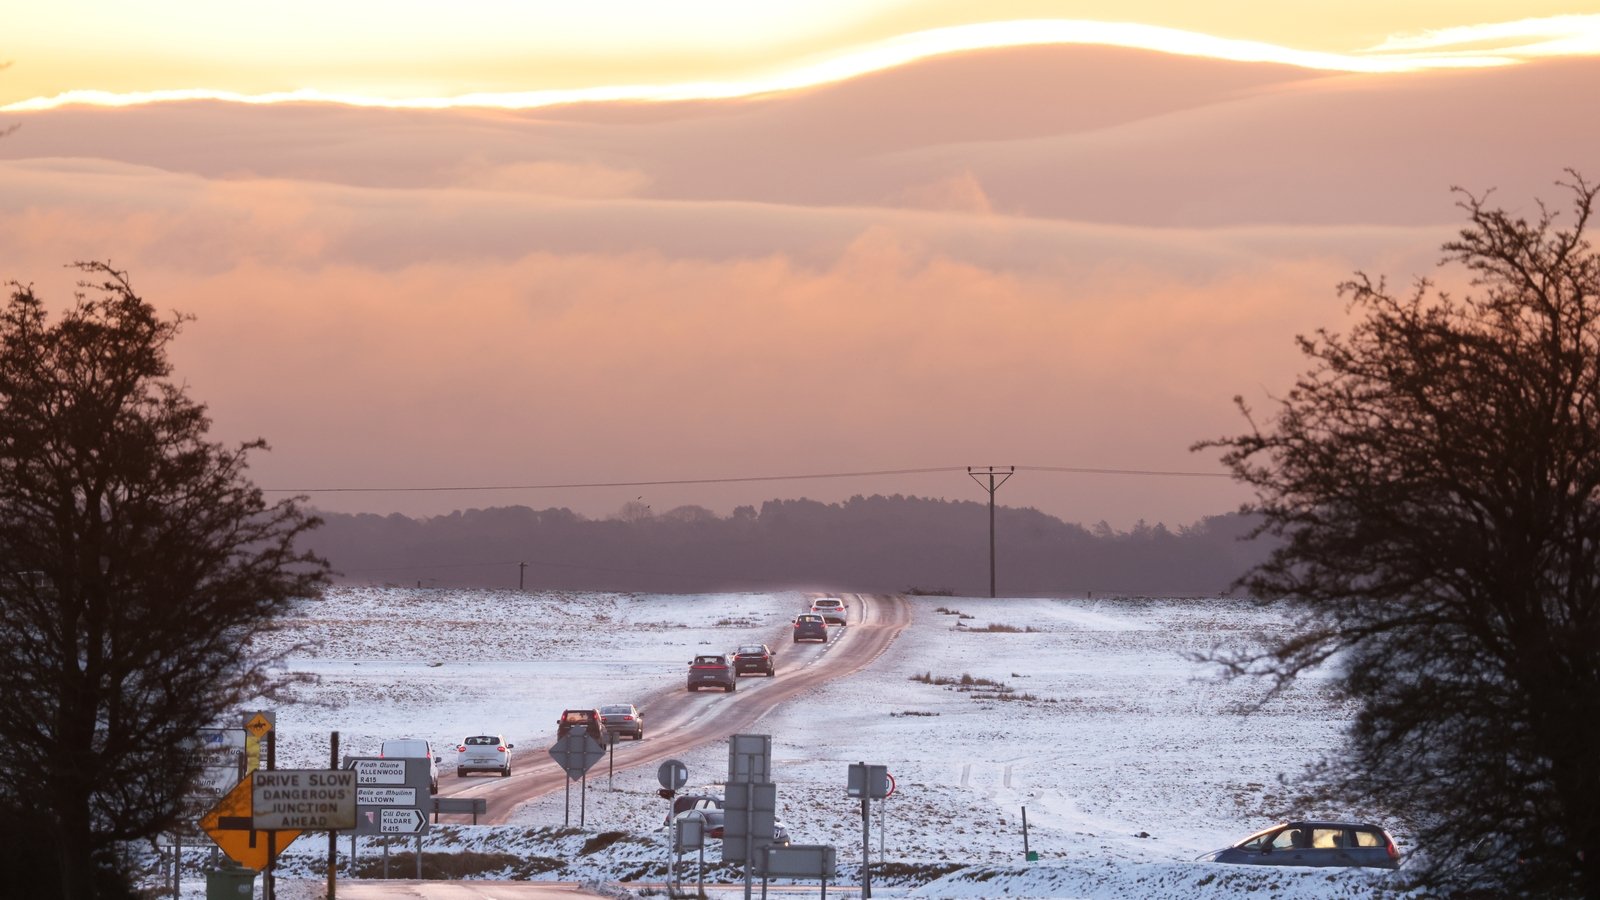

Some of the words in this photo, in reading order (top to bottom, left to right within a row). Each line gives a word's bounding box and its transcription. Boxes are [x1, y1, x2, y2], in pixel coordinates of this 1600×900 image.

[256, 774, 299, 786] DRIVE
[309, 774, 351, 786] SLOW
[263, 790, 345, 800] DANGEROUS
[272, 803, 338, 813] JUNCTION
[282, 816, 328, 826] AHEAD
